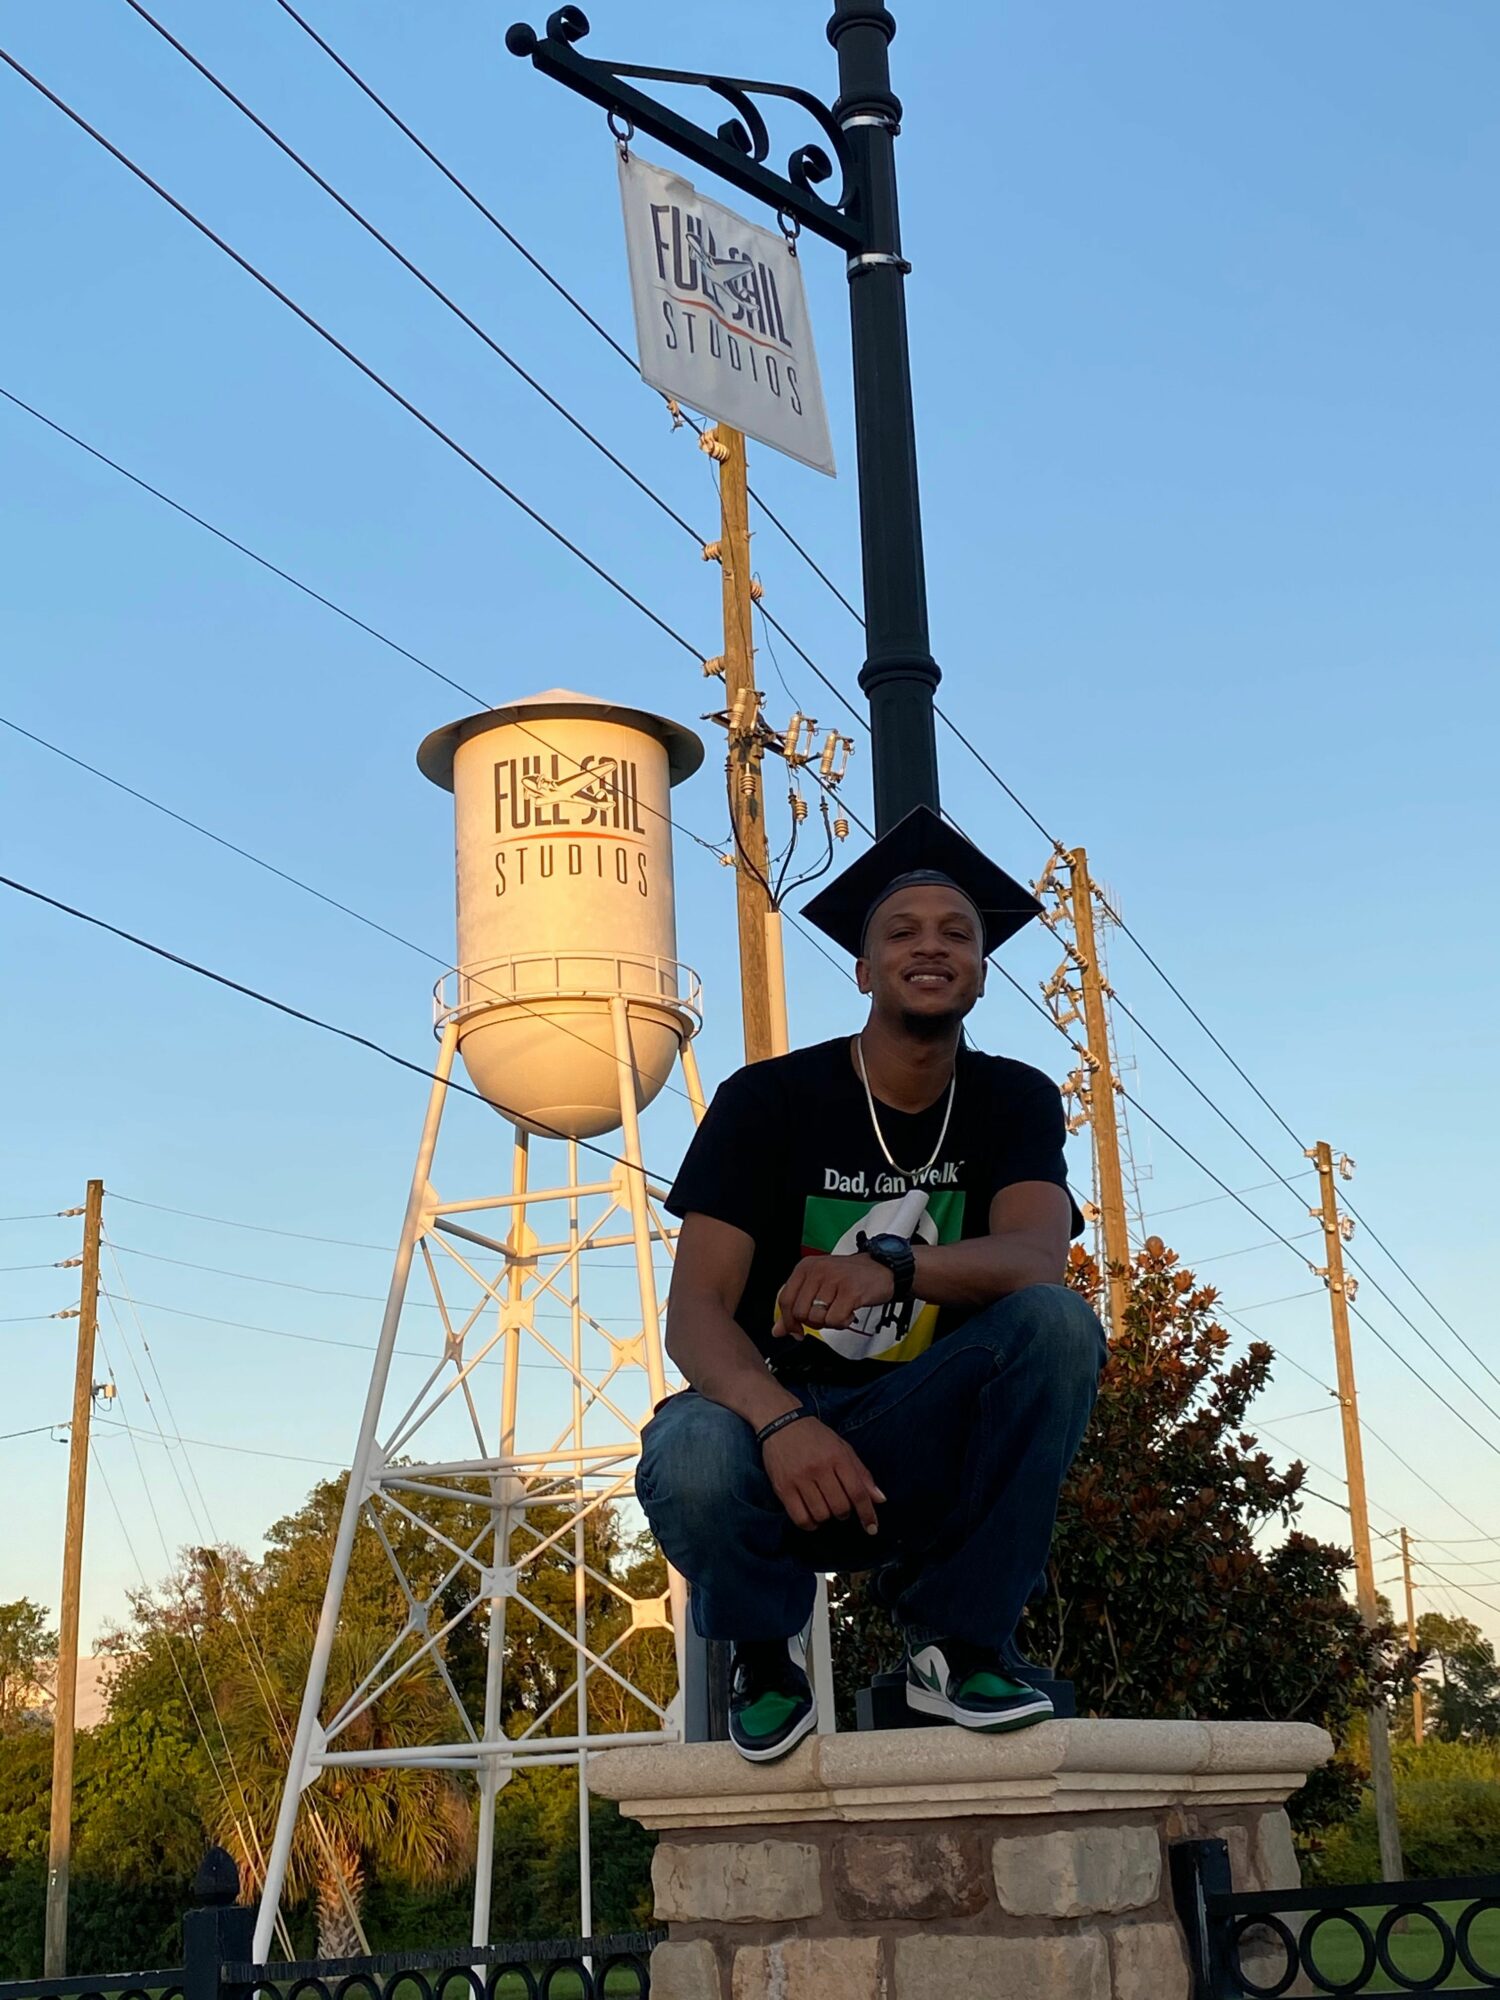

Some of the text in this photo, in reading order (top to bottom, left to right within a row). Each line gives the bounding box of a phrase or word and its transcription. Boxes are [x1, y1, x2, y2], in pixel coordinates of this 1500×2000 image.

[650, 203, 792, 348] FULL SAIL
[662, 300, 802, 416] STUDIOS
[494, 754, 645, 835] FULL SAIL
[495, 844, 648, 897] STUDIOS
[823, 1167, 870, 1198] Dad,
[874, 1172, 907, 1194] Can
